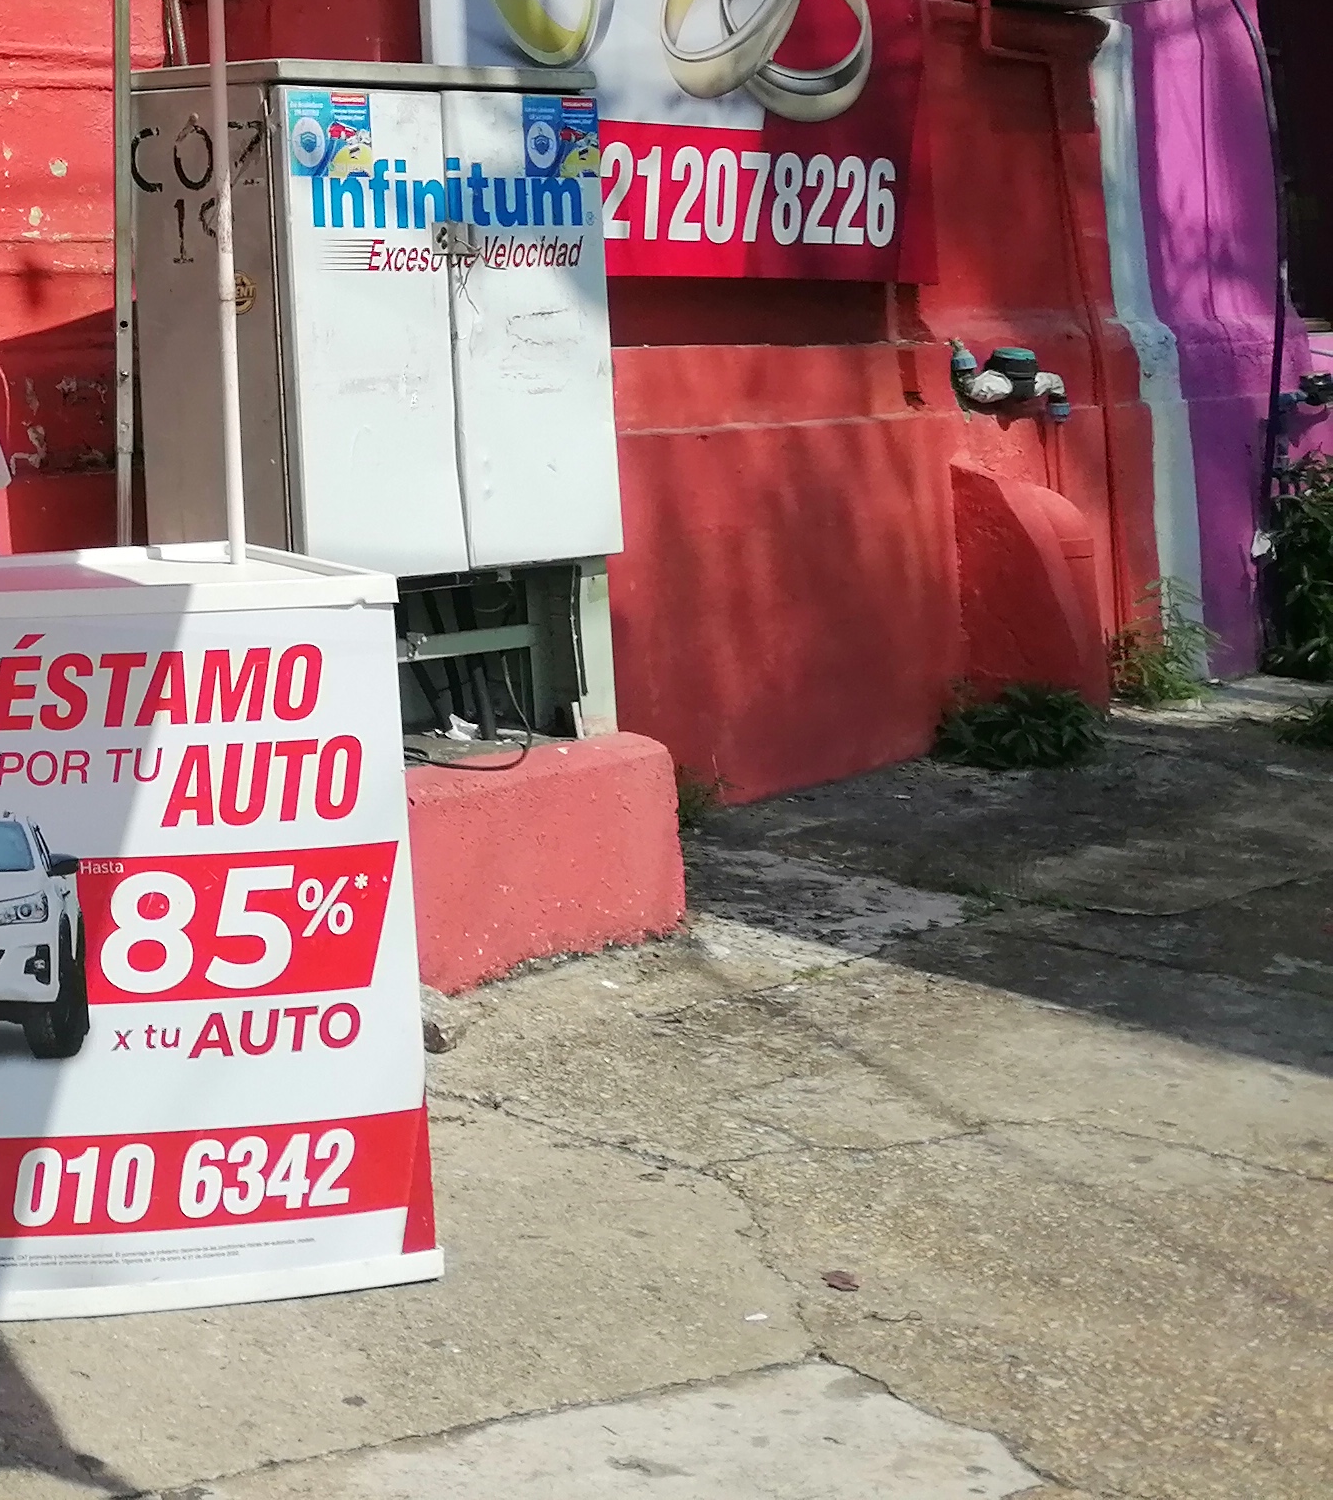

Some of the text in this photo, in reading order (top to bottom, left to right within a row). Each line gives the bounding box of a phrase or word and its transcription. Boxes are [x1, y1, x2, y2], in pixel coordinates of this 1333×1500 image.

[599, 141, 896, 247] 212078226
[484, 235, 584, 269] Velocidad
[104, 747, 163, 784] TU
[160, 734, 364, 829] AUTO
[80, 860, 125, 876] Hasta
[144, 1023, 181, 1050] tu
[187, 1002, 362, 1060] AUTO
[11, 1142, 156, 1228] 010
[178, 1127, 357, 1219] 6342
